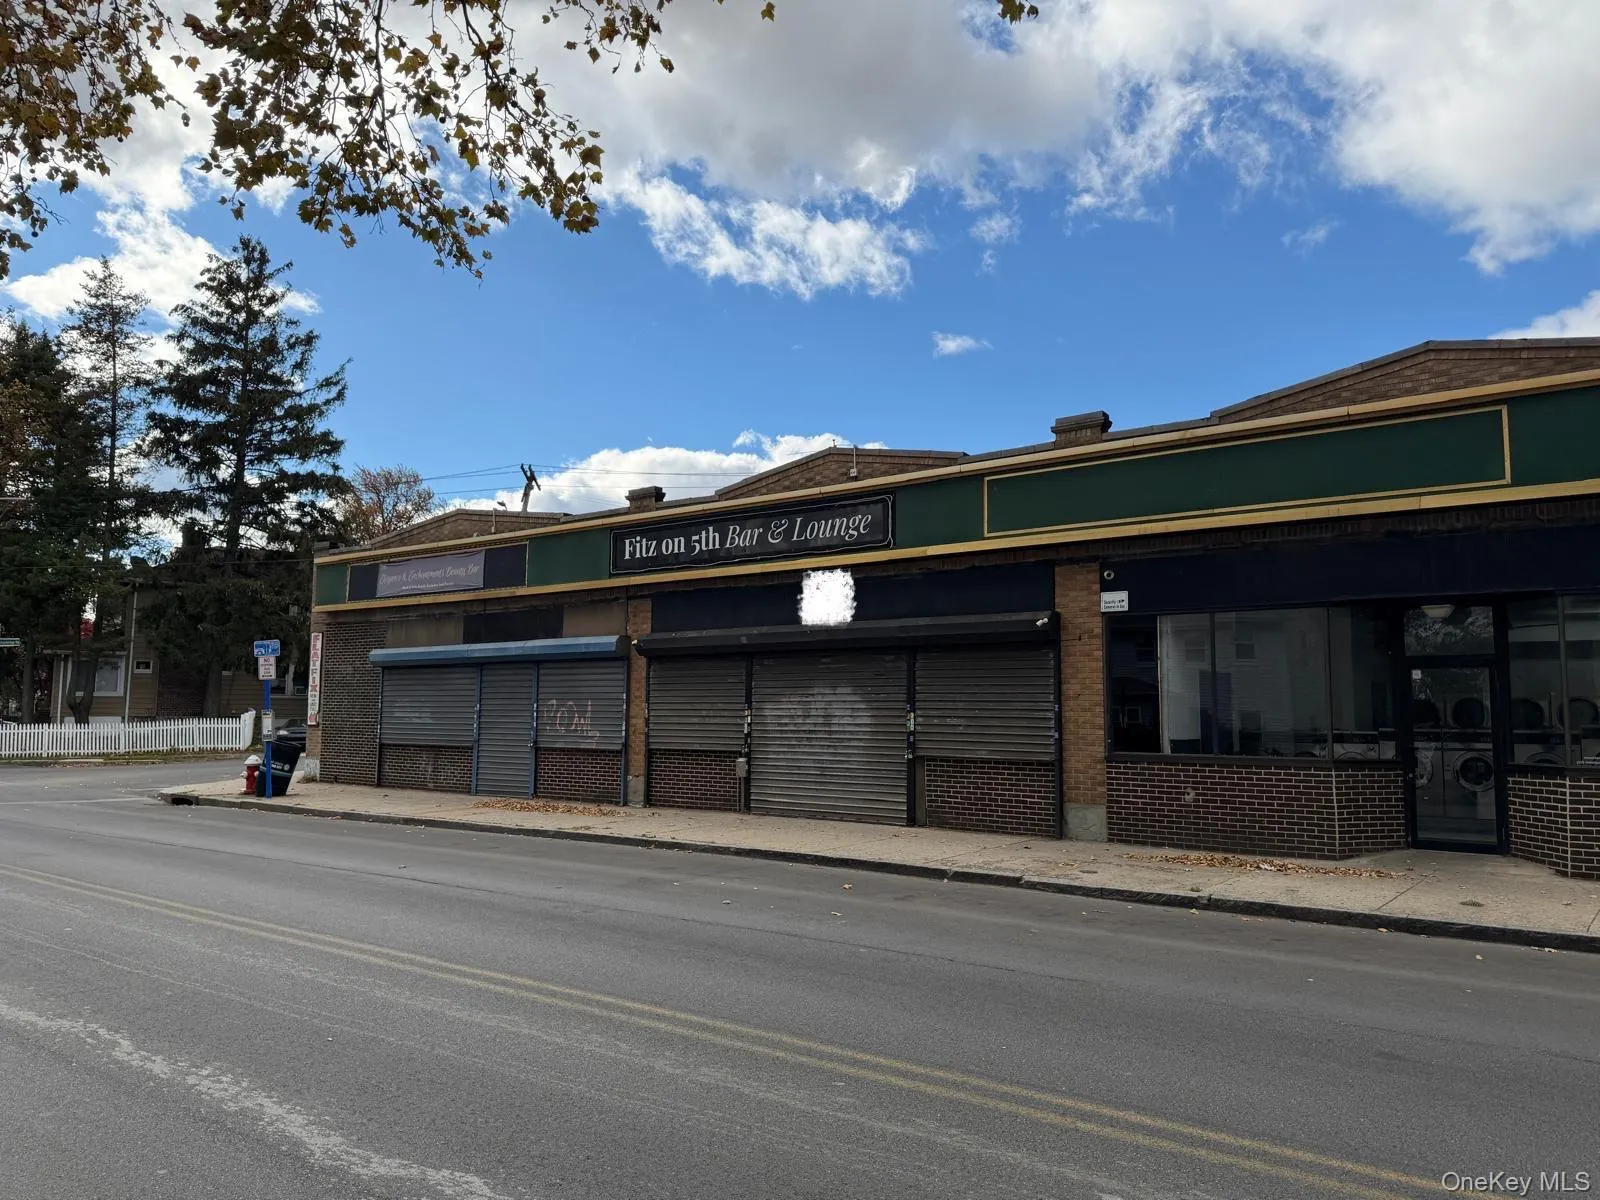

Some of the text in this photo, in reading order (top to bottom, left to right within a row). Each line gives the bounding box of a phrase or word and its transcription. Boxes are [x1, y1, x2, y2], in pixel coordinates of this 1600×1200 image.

[624, 514, 872, 560] Fitz on 5th Bar & Lounge
